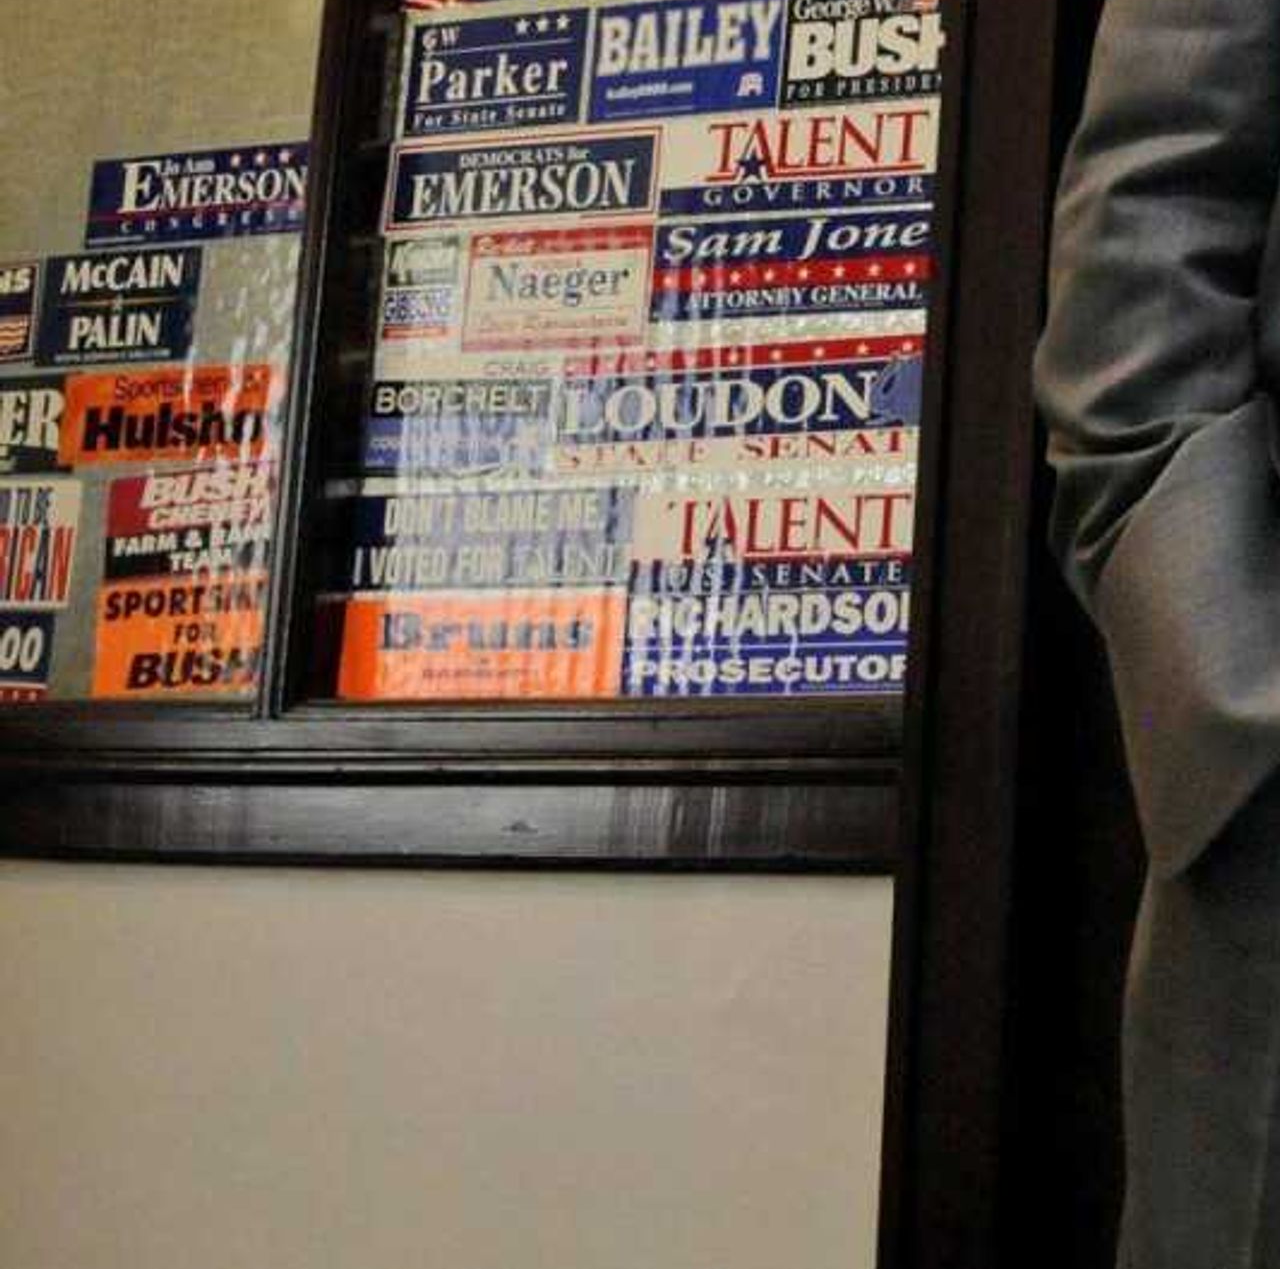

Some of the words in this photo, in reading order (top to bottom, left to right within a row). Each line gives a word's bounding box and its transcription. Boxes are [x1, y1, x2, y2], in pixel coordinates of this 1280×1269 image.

[417, 52, 569, 104] Parker
[709, 111, 930, 180] TALENT
[117, 161, 308, 214] EMERSON
[410, 159, 635, 219] EMERSON
[702, 177, 924, 206] GOVERNOR
[662, 225, 783, 263] Sam
[60, 253, 184, 294] McCAIN
[487, 260, 632, 309] Naeger
[686, 286, 808, 310] ATTORNEY
[811, 281, 922, 306] GENERAL
[69, 312, 162, 350] PALIN
[556, 370, 878, 434] LOUDON
[114, 533, 177, 555] FARM
[667, 493, 912, 555] TALENT
[752, 561, 903, 586] SENATE
